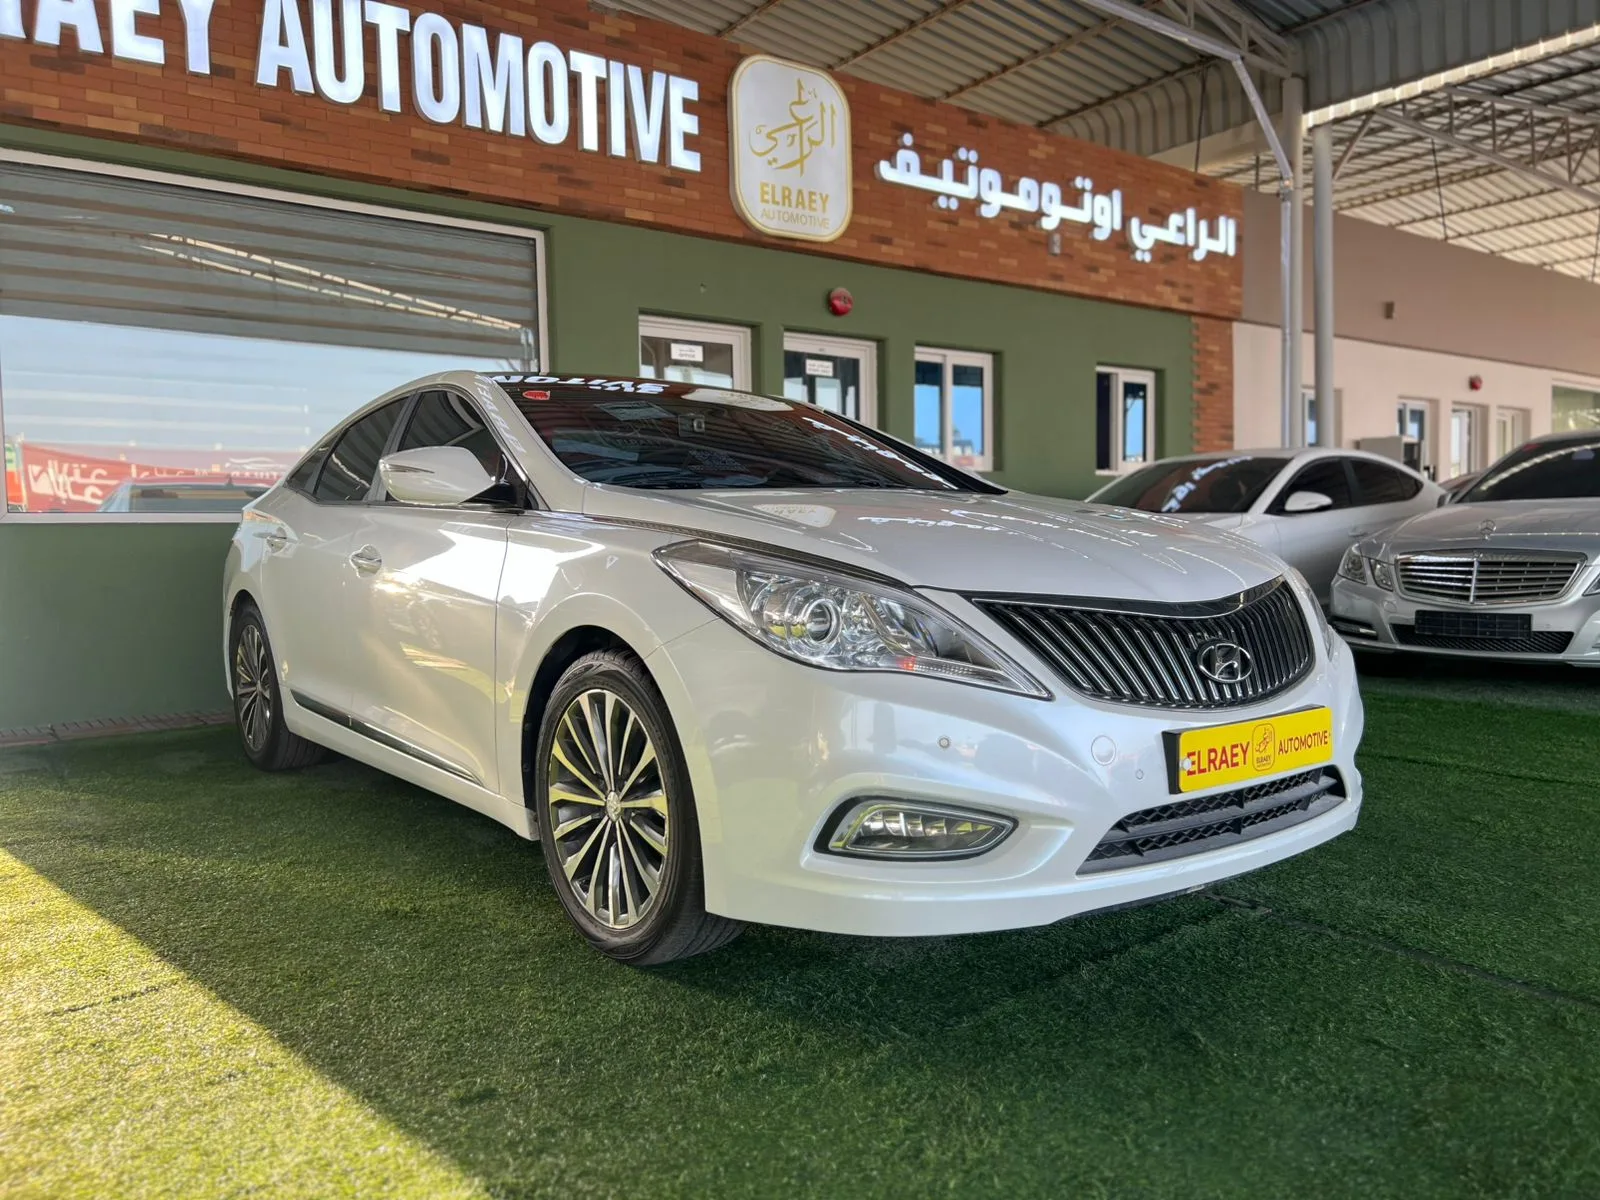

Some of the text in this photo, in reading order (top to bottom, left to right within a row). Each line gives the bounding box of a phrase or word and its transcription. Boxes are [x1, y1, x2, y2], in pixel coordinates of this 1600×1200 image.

[255, 0, 701, 172] AUTOMOTIVE
[759, 181, 830, 213] ELRAEY
[760, 207, 831, 230] AUTOMOTIVE
[878, 132, 1236, 263] الراعي اوتوموتيف
[1186, 741, 1250, 776] ELRAEY
[1278, 730, 1328, 756] AUTOMOTIVE
